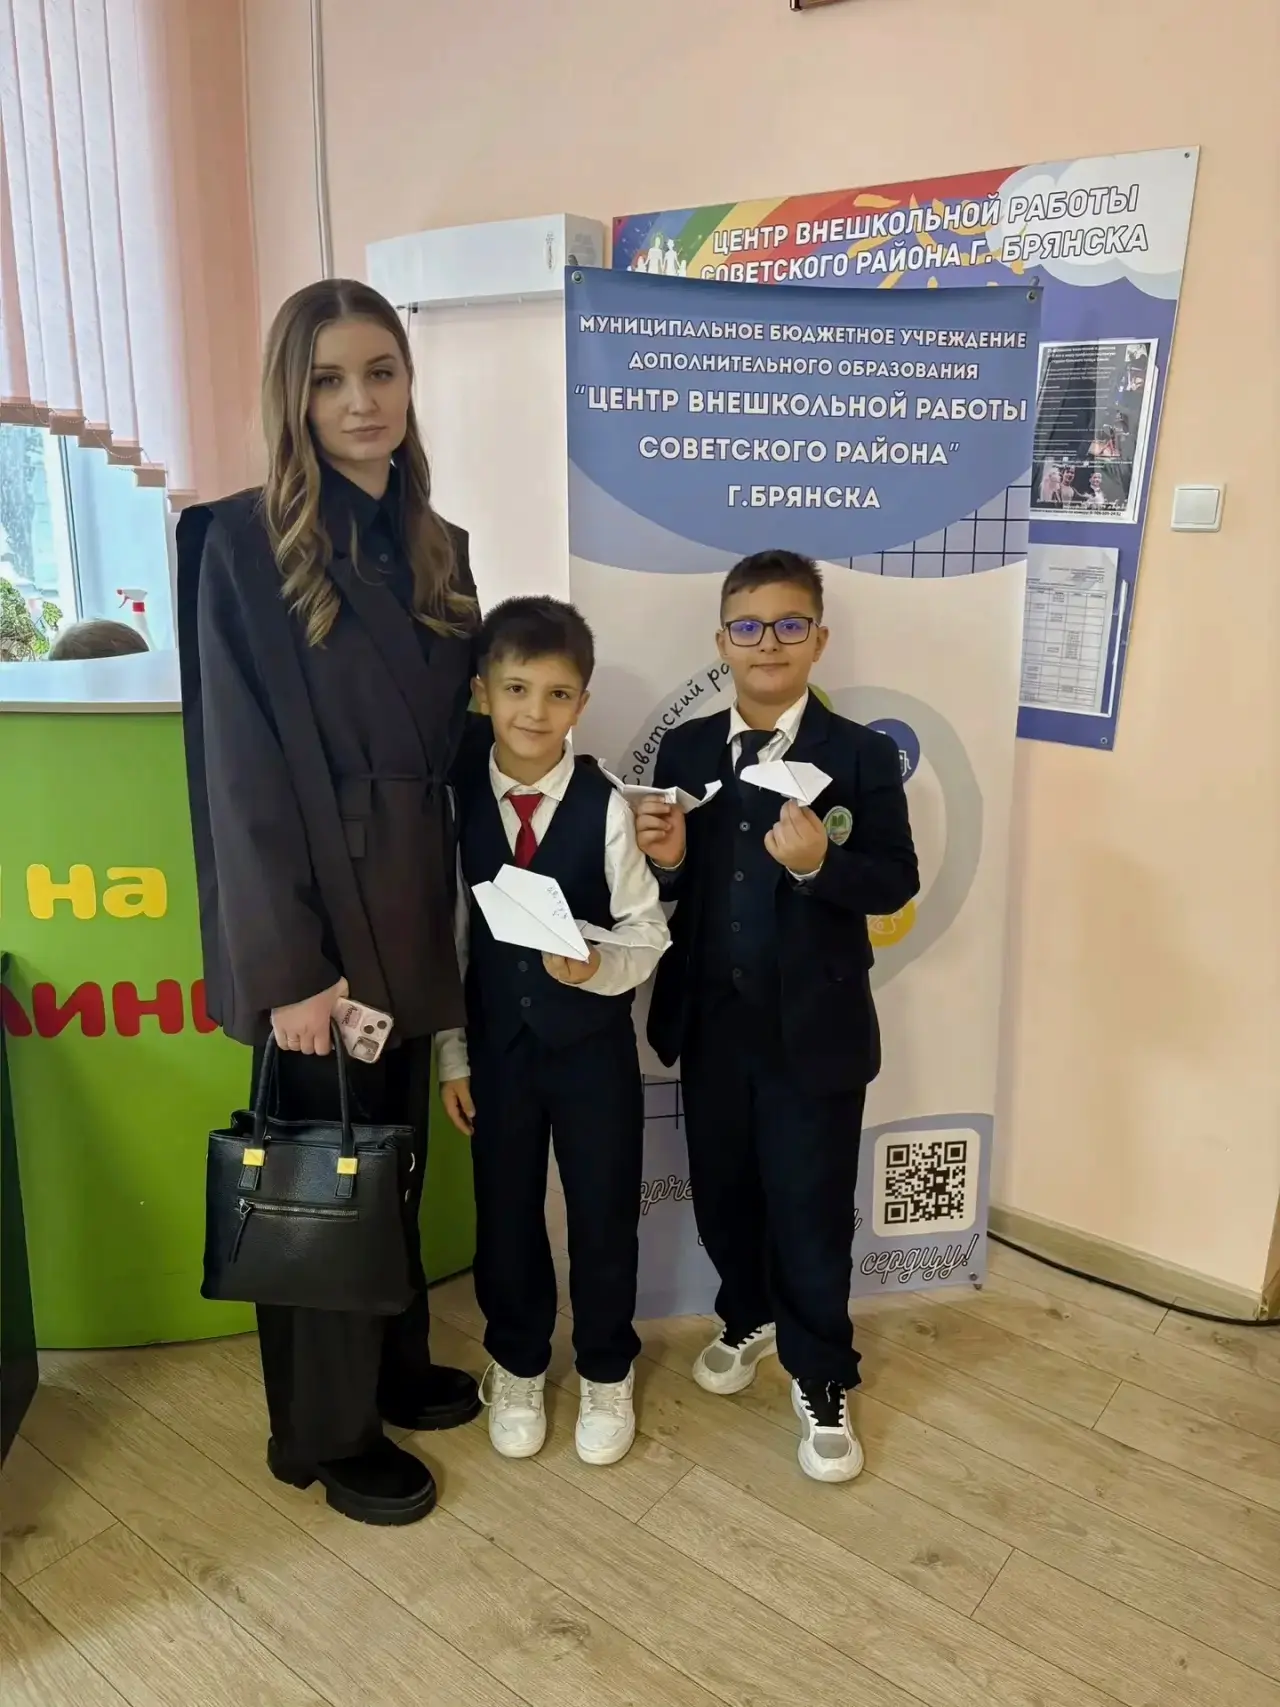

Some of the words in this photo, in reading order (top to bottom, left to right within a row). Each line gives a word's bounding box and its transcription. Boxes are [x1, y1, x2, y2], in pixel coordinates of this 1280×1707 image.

[713, 221, 789, 256] ЦЕНТР
[795, 193, 1003, 246] ВНЕШКОЛЬНОЙ
[1007, 184, 1140, 224] РАБОТЫ
[701, 251, 849, 284] СОВЕТСКОГО
[855, 240, 961, 277] РАЙОНА
[969, 239, 993, 265] Г.
[1000, 223, 1149, 262] БРЯНСКА
[579, 314, 764, 342] МУНИЦИПАЛЬНОЕ
[769, 324, 896, 346] БЮДЖЕТНОЕ
[900, 328, 1028, 350] УЧРЕЖДЕНИЕ
[628, 351, 833, 376] ДОПОЛНИТЕЛЬНОГО
[838, 359, 980, 381] ОБРАЗОВАНИЯ
[688, 390, 908, 420] ВНЕШКОЛЬНОЙ
[915, 398, 1028, 422] РАБОТЫ
[638, 435, 827, 463] СОВЕТСКОГО
[727, 484, 881, 510] Г.БРЯНСКА
[26, 863, 168, 920] на
[860, 1233, 980, 1284] сердцу!
